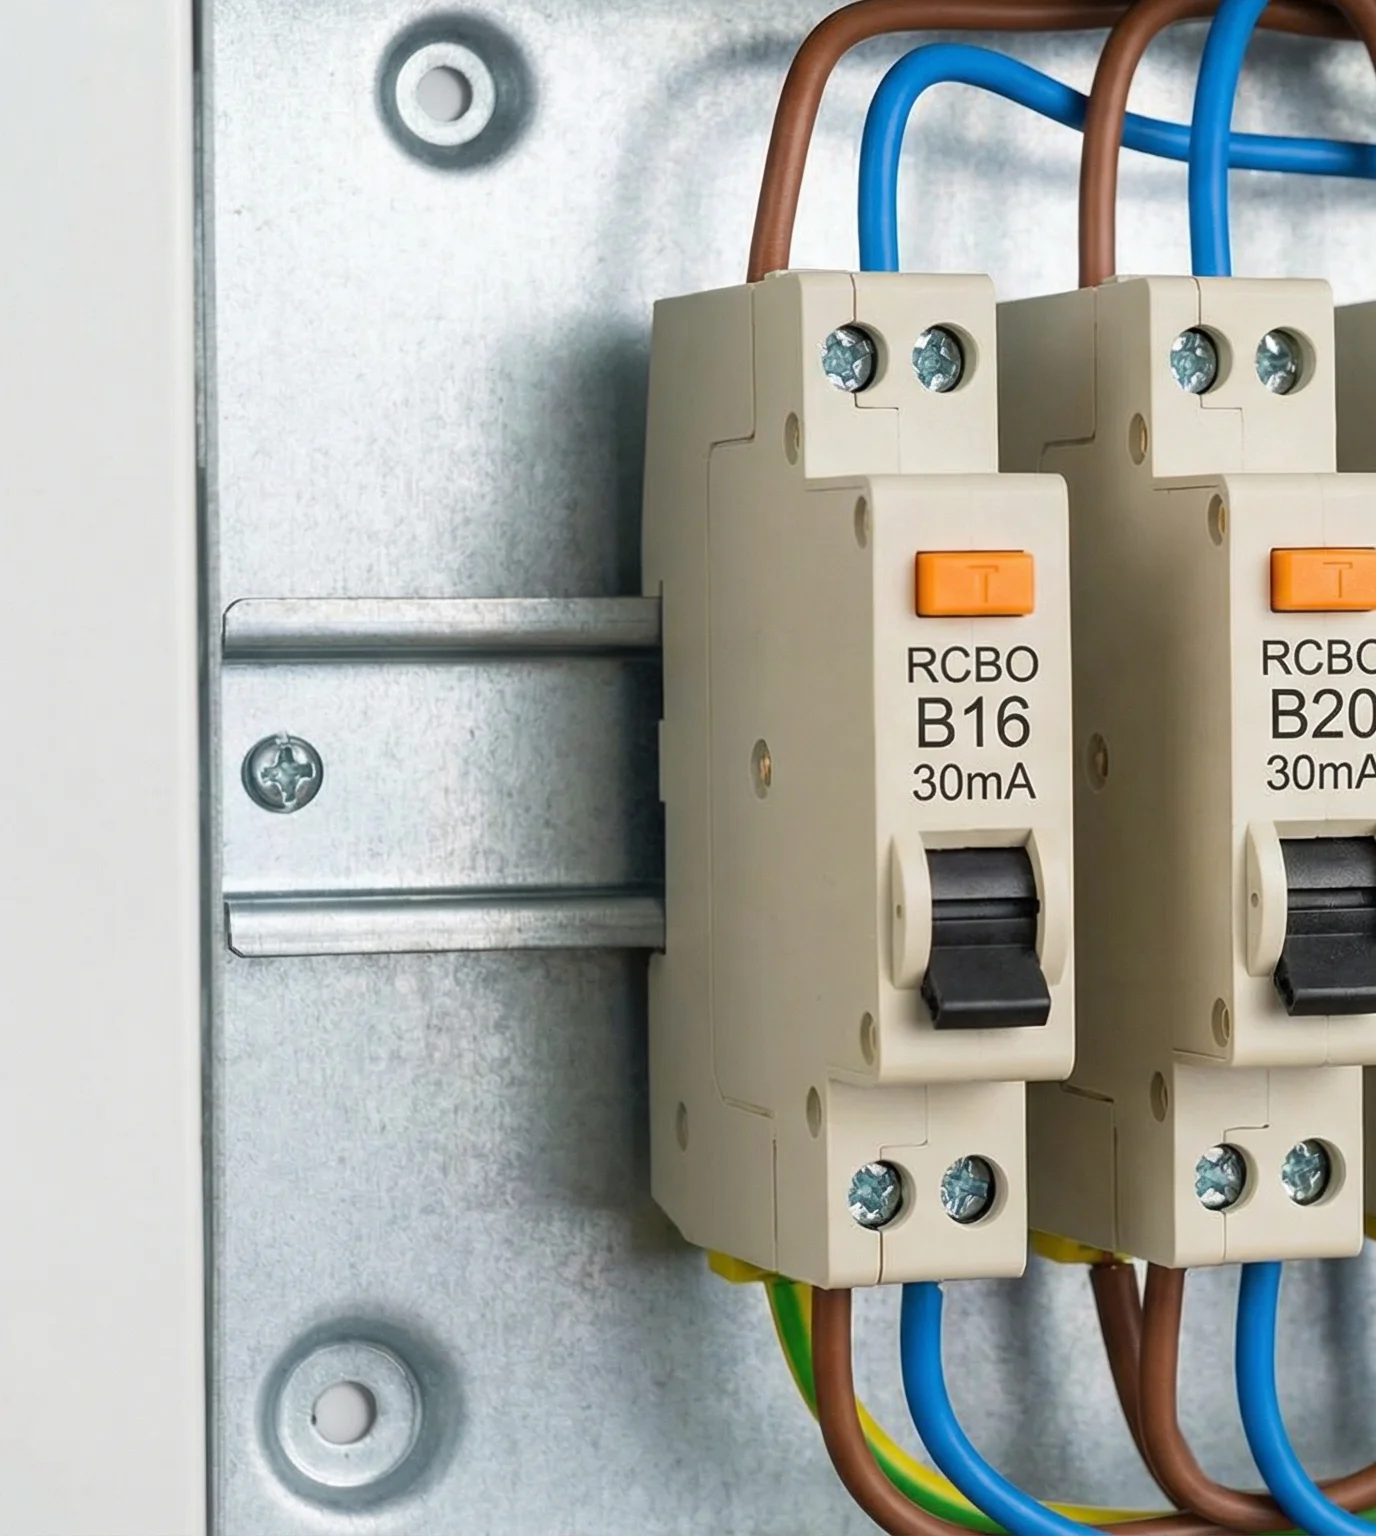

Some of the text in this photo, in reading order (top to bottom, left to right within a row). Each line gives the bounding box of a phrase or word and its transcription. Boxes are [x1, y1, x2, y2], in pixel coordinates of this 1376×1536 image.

[966, 564, 1000, 604] T
[1322, 561, 1354, 599] T
[907, 645, 1040, 684] RCBO
[917, 695, 1031, 749] B16
[912, 761, 1037, 801] 30mA
